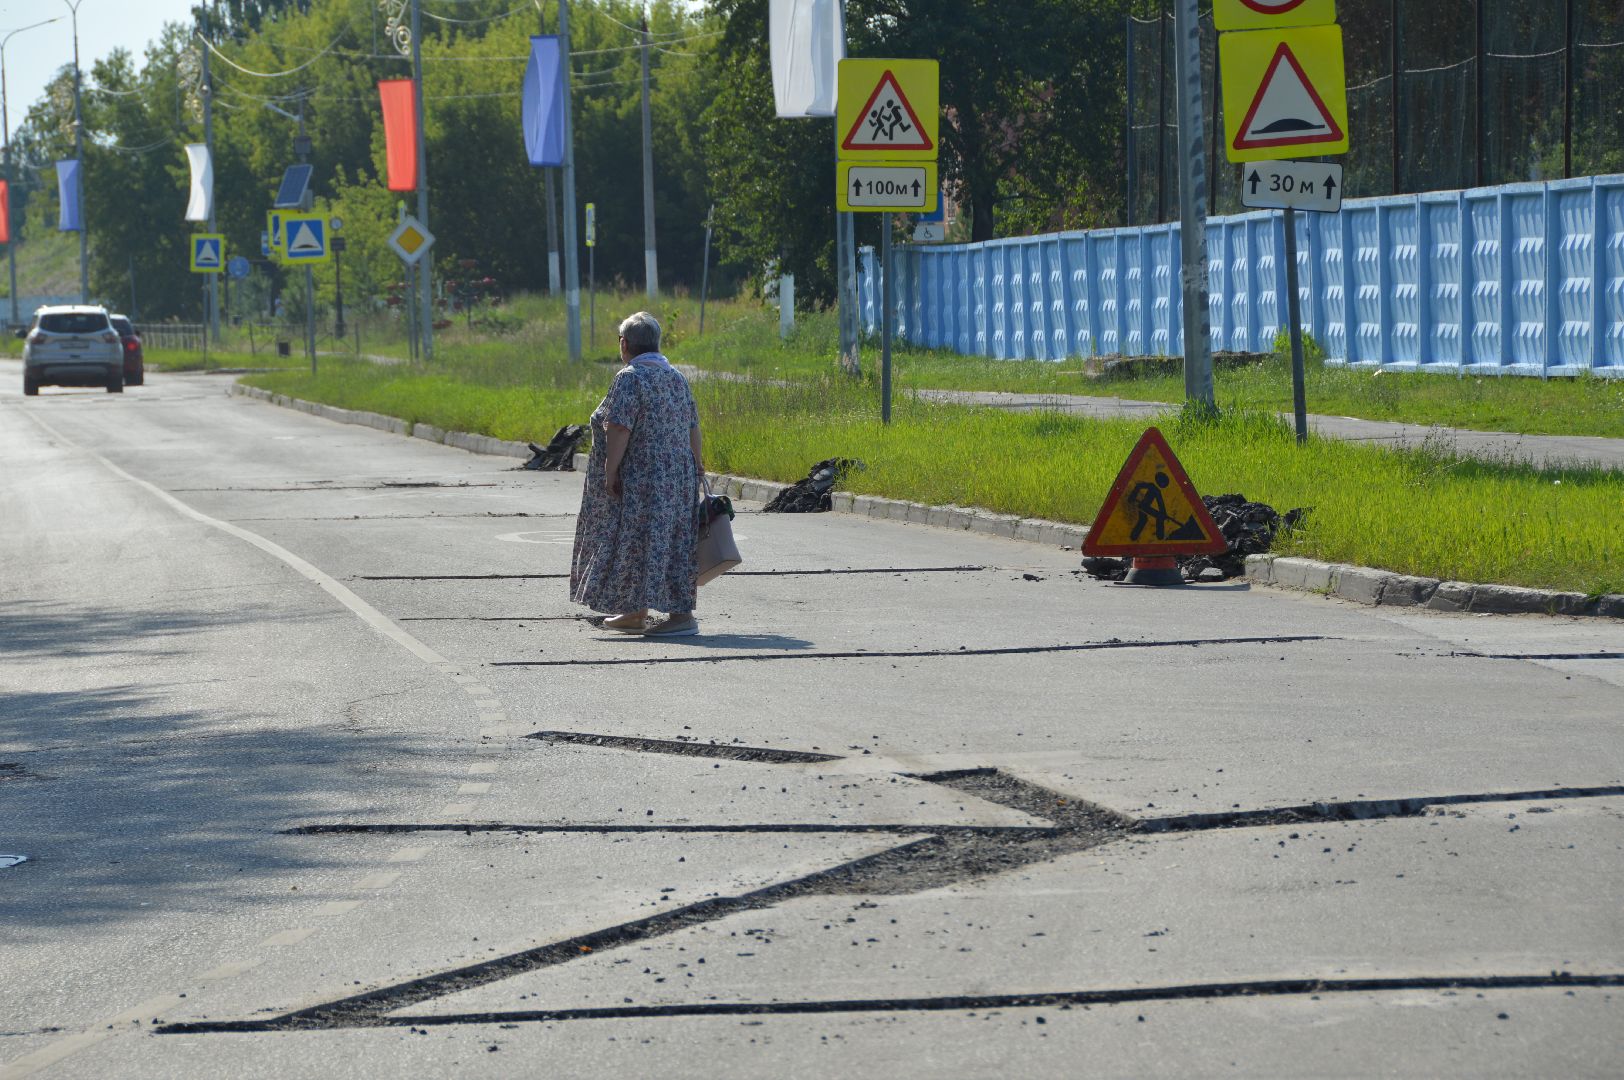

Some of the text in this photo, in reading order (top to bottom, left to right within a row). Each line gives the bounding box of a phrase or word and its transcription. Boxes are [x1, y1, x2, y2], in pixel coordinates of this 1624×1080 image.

[866, 180, 908, 195] 100м
[1269, 173, 1314, 195] 30 м
